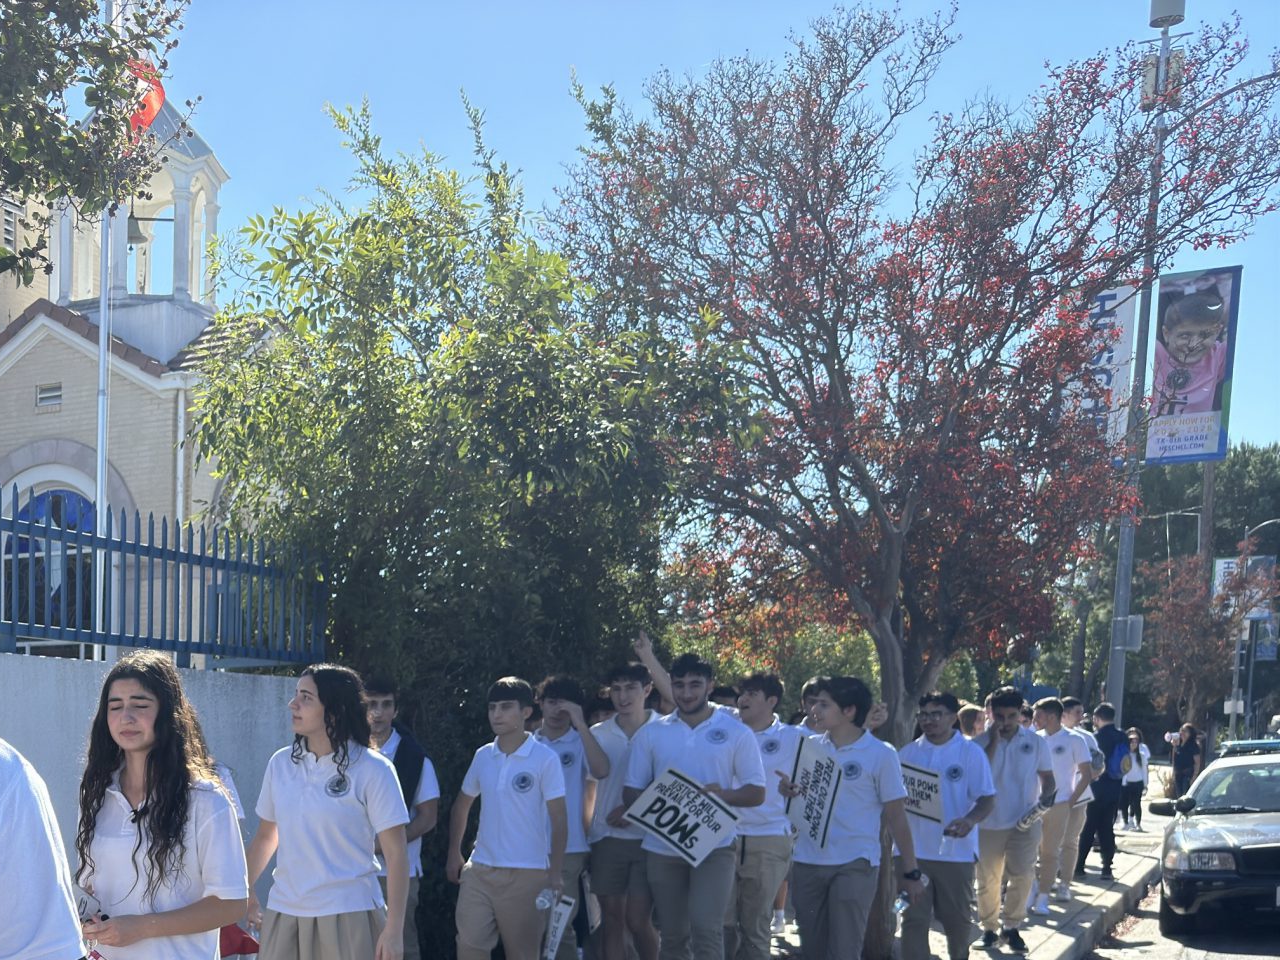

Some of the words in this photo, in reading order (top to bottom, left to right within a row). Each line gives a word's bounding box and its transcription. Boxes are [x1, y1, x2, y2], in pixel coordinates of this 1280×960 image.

[799, 767, 812, 801] HOME
[810, 760, 824, 795] BRING
[822, 756, 835, 787] FREE
[654, 782, 684, 806] PREVAIL
[683, 800, 703, 818] FOR
[701, 816, 722, 834] OUR
[669, 779, 701, 804] JUSTICE
[698, 798, 718, 818] WILL
[803, 792, 817, 822] THEM
[816, 786, 828, 810] OUR
[904, 797, 921, 809] OME
[809, 808, 822, 841] POWS
